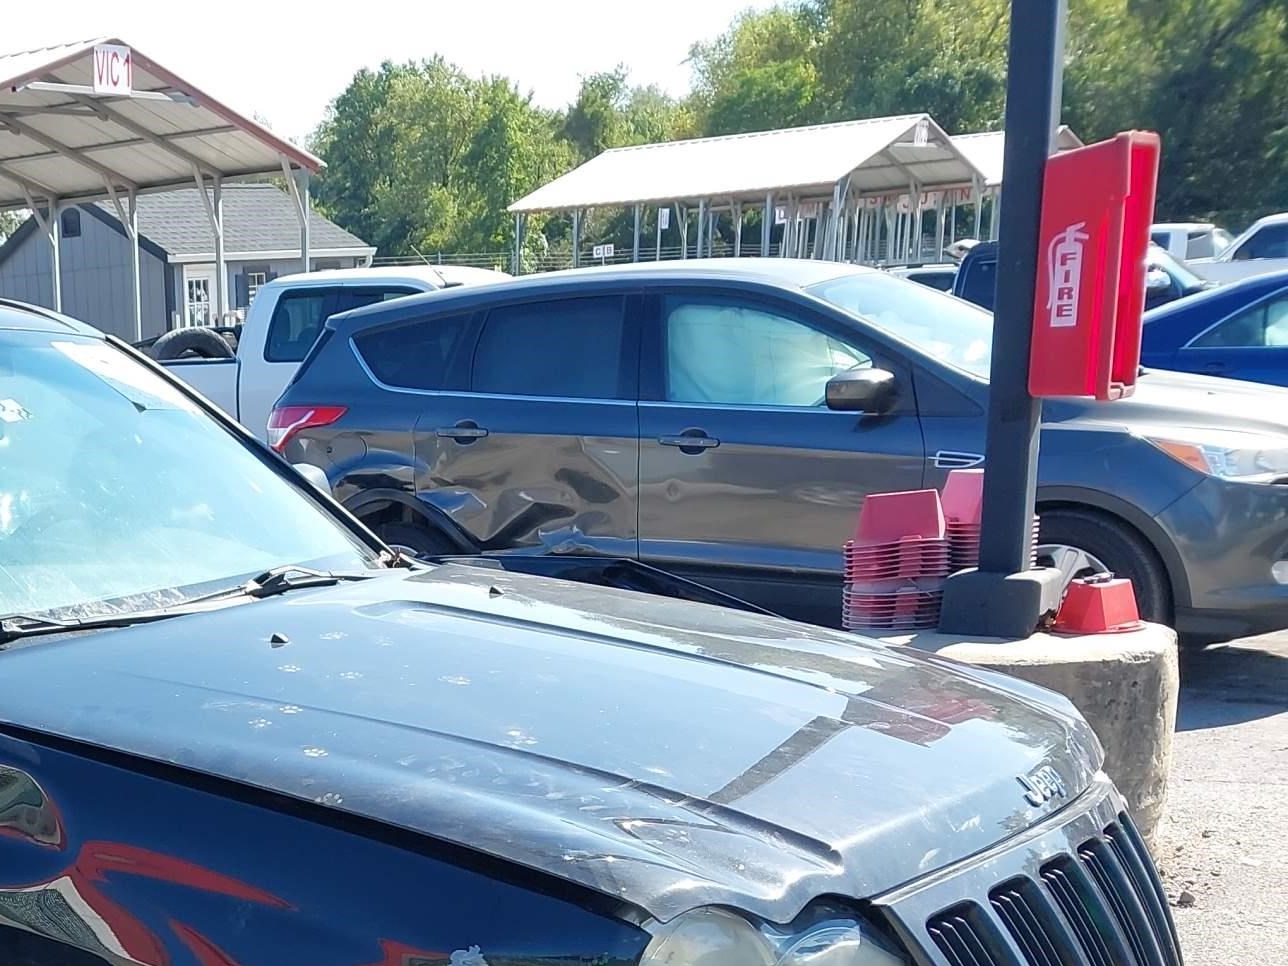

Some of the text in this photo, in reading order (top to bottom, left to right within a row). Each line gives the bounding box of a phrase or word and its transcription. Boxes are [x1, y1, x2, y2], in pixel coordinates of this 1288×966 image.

[95, 50, 131, 88] VIC 1
[1056, 252, 1077, 318] FIRE
[1015, 764, 1067, 808] Jeep
